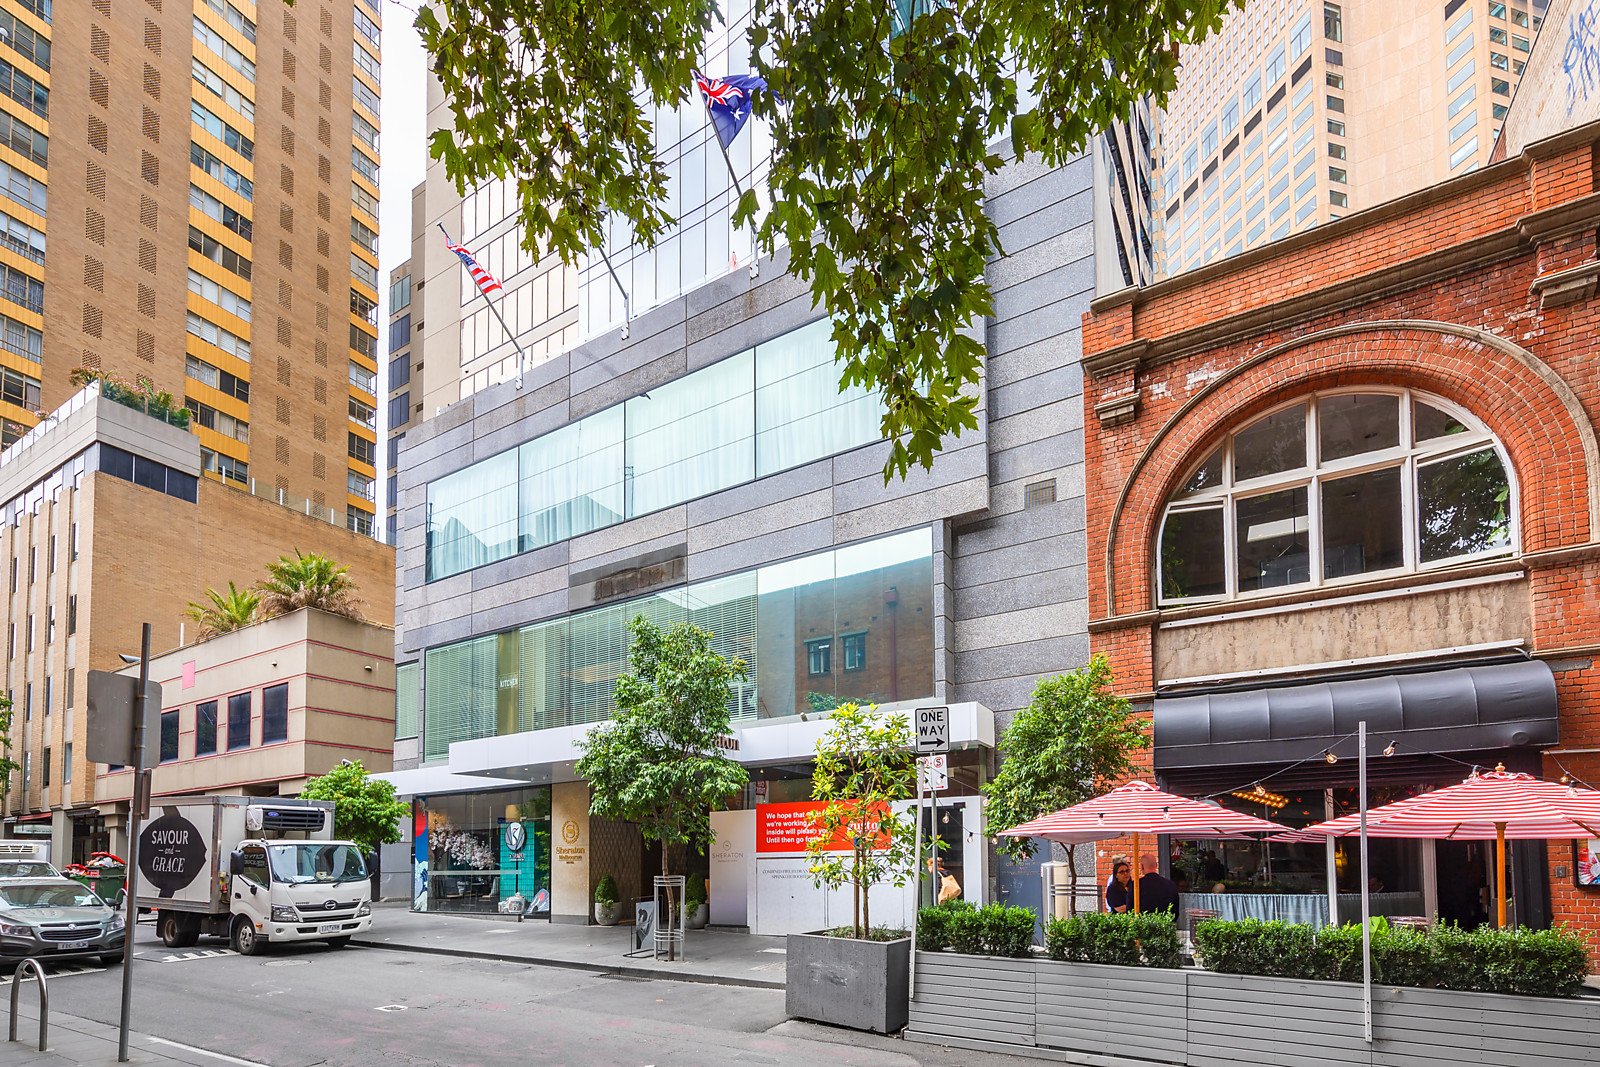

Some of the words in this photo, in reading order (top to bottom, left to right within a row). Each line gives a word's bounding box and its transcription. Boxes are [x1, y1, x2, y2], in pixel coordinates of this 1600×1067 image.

[920, 711, 944, 723] ONE
[919, 724, 946, 736] WAY
[777, 812, 792, 820] hope
[783, 818, 807, 828] working
[785, 827, 796, 835] will
[796, 827, 817, 836] please
[151, 830, 189, 845] SAVOUR
[766, 836, 780, 844] Until
[795, 836, 804, 844] go
[164, 845, 175, 855] and
[556, 846, 585, 854] Sheraton
[152, 856, 186, 873] GRACE
